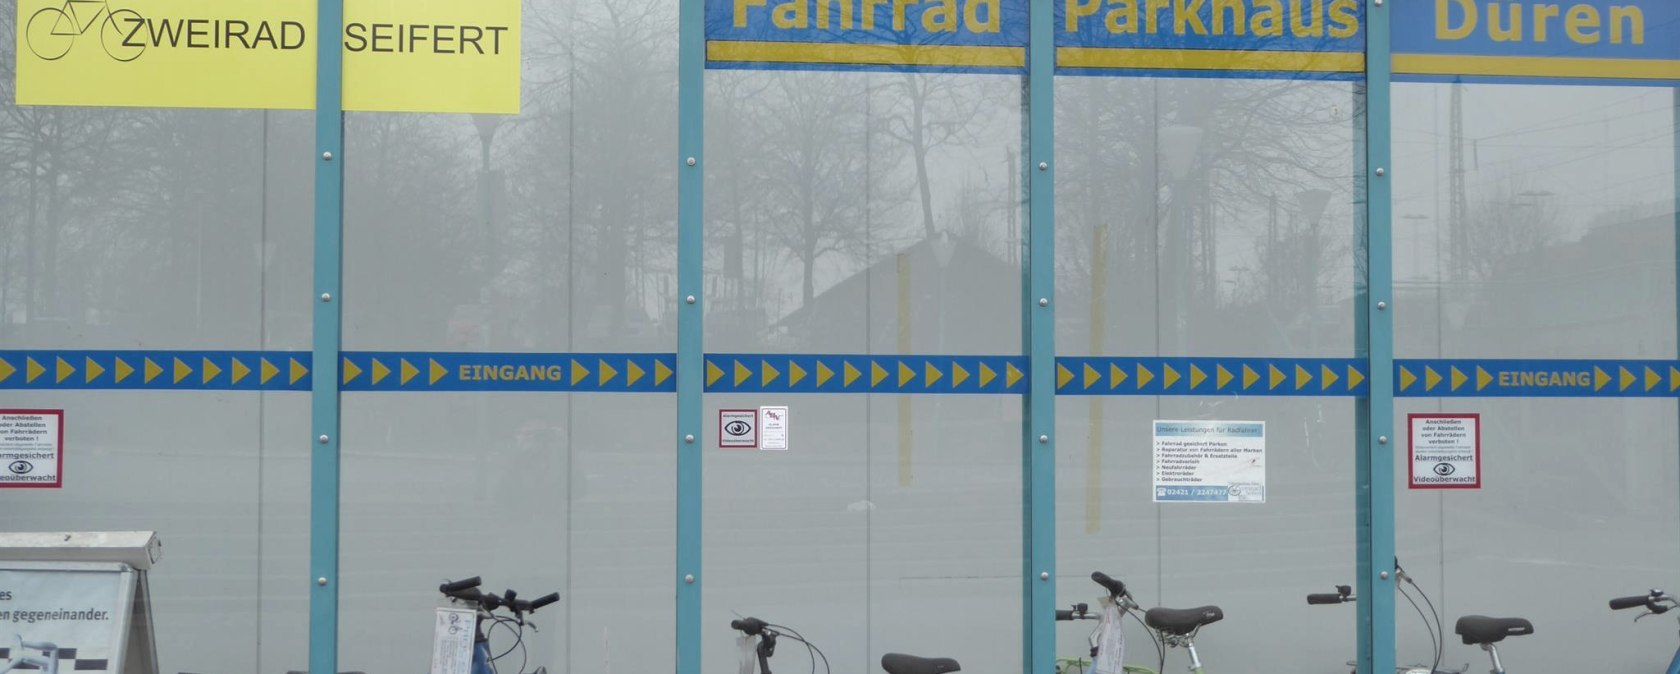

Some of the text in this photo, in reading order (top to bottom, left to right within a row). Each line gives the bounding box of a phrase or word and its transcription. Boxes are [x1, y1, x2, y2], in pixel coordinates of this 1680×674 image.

[121, 17, 509, 56] ZWEIRAD SEIFERT
[459, 364, 562, 381] EINGANG
[1498, 371, 1591, 387] EINGANG
[1156, 425, 1179, 433] Unsere
[1180, 425, 1215, 434] Leistungen
[1216, 425, 1226, 433] für
[1415, 454, 1473, 462] Alarmgesichert
[12, 608, 109, 623] gegeneinander.
